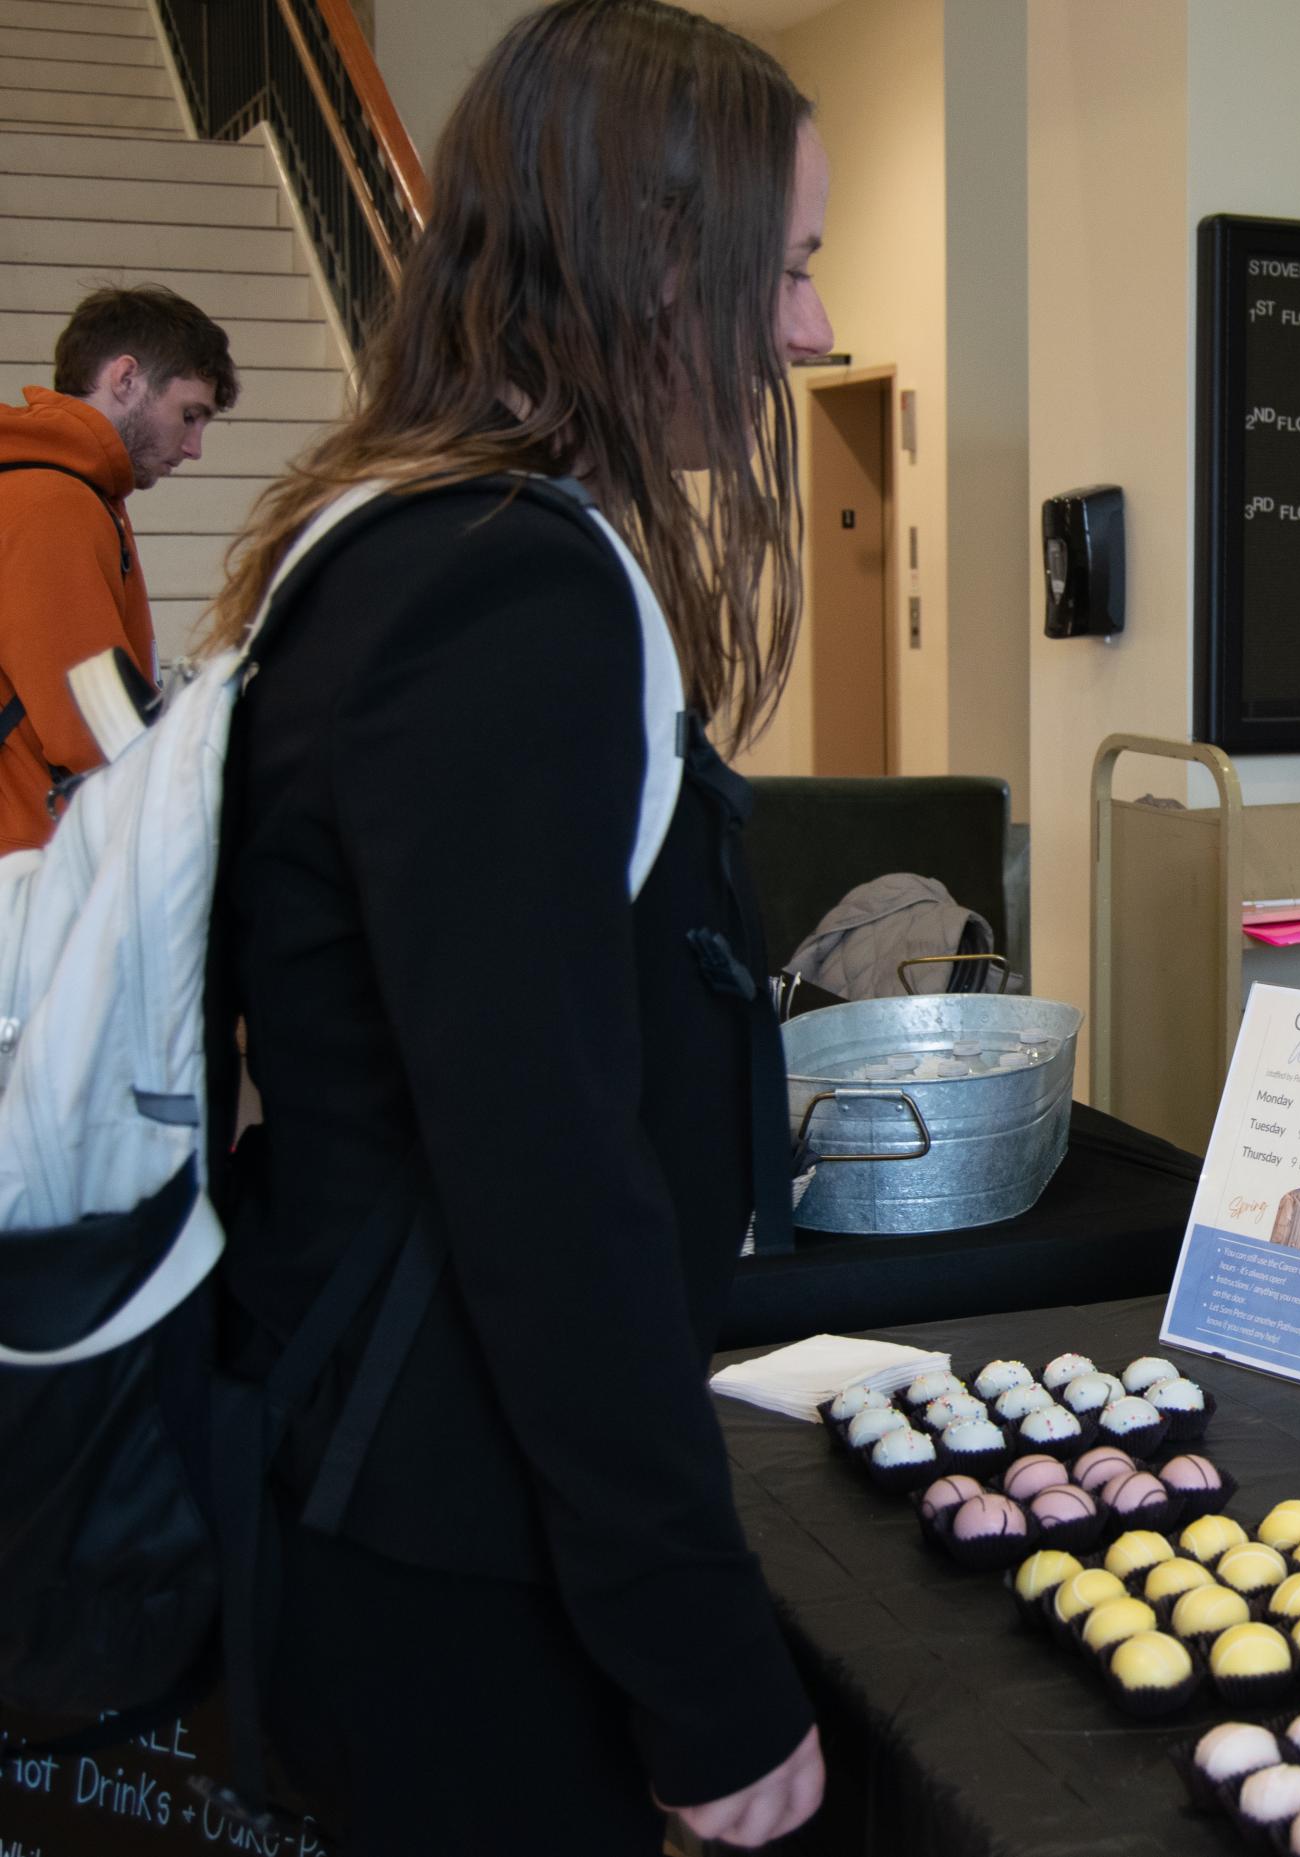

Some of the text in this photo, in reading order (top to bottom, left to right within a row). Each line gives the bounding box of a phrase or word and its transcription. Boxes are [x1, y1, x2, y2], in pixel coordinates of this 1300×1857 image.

[1256, 1090, 1294, 1109] Monday
[1250, 1118, 1286, 1138] Tuesday
[1242, 1146, 1282, 1166] Thursday
[1291, 1157, 1298, 1168] 9
[76, 1756, 172, 1825] Drinks
